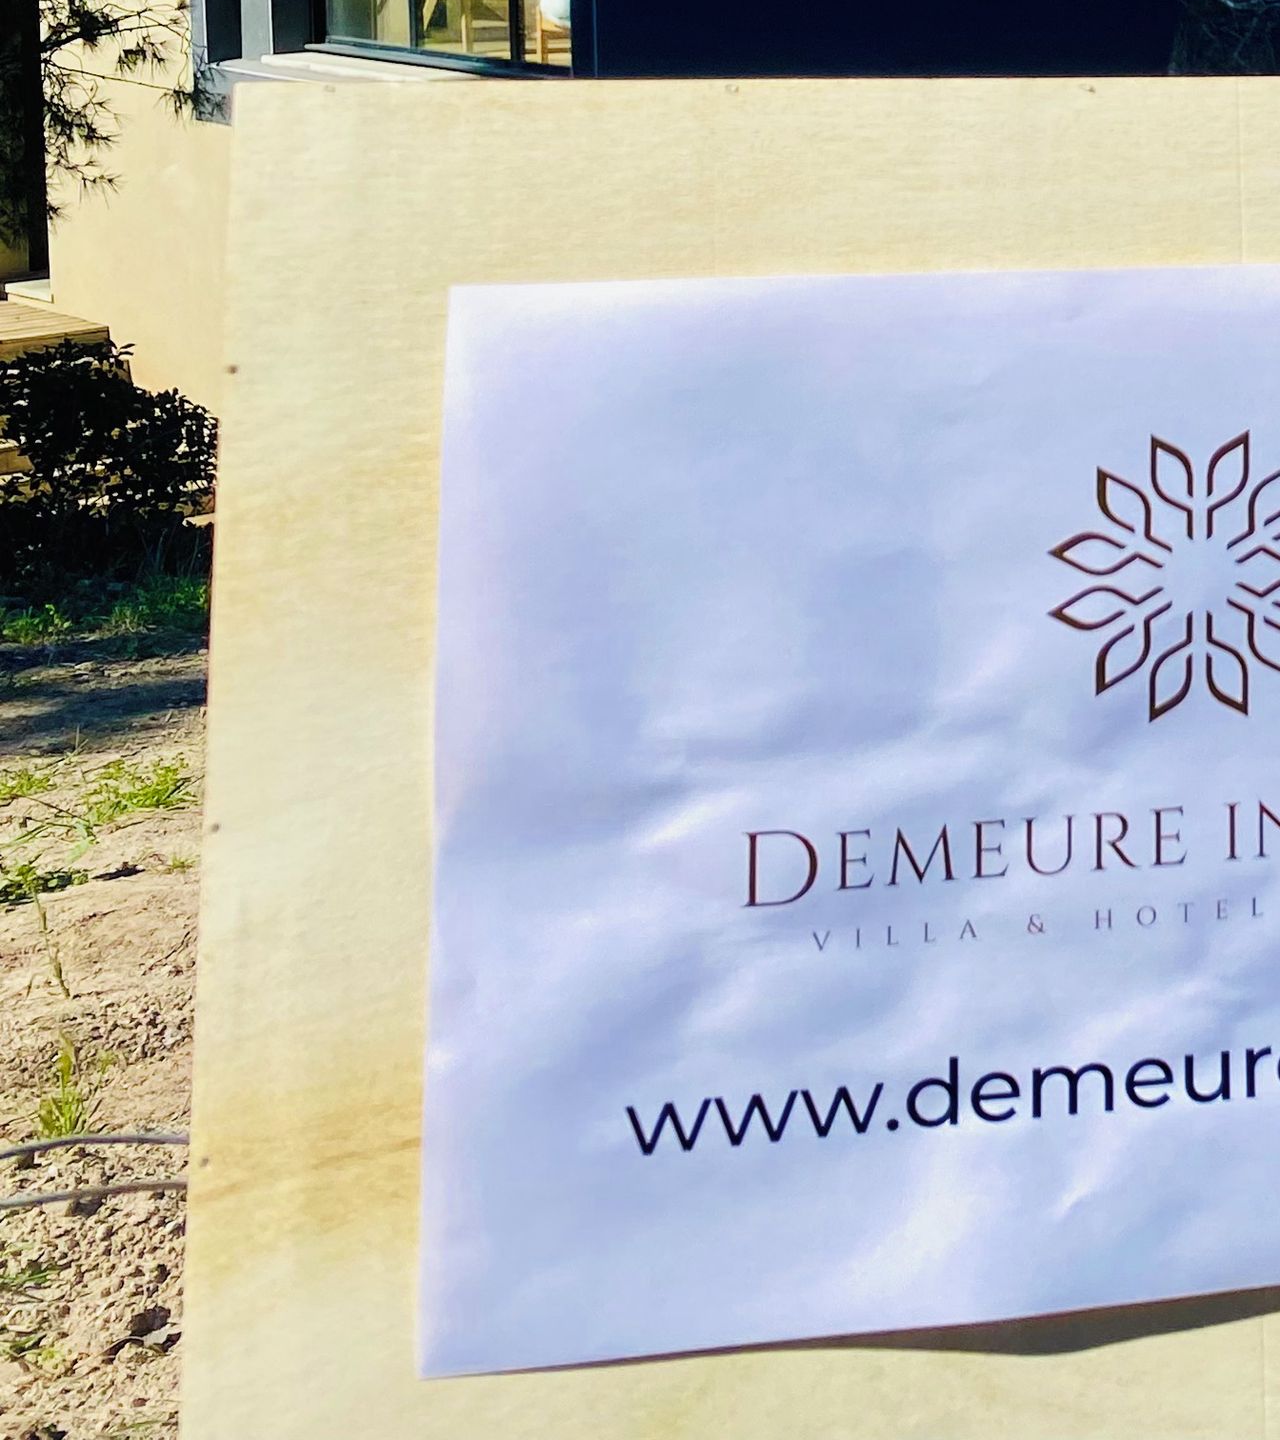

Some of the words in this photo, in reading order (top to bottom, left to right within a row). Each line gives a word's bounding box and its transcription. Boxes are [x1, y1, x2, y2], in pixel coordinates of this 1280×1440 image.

[740, 804, 1189, 910] DEMEURE
[812, 919, 978, 953] VILLA
[1026, 913, 1046, 936] &
[1093, 895, 1264, 931] HOTEL
